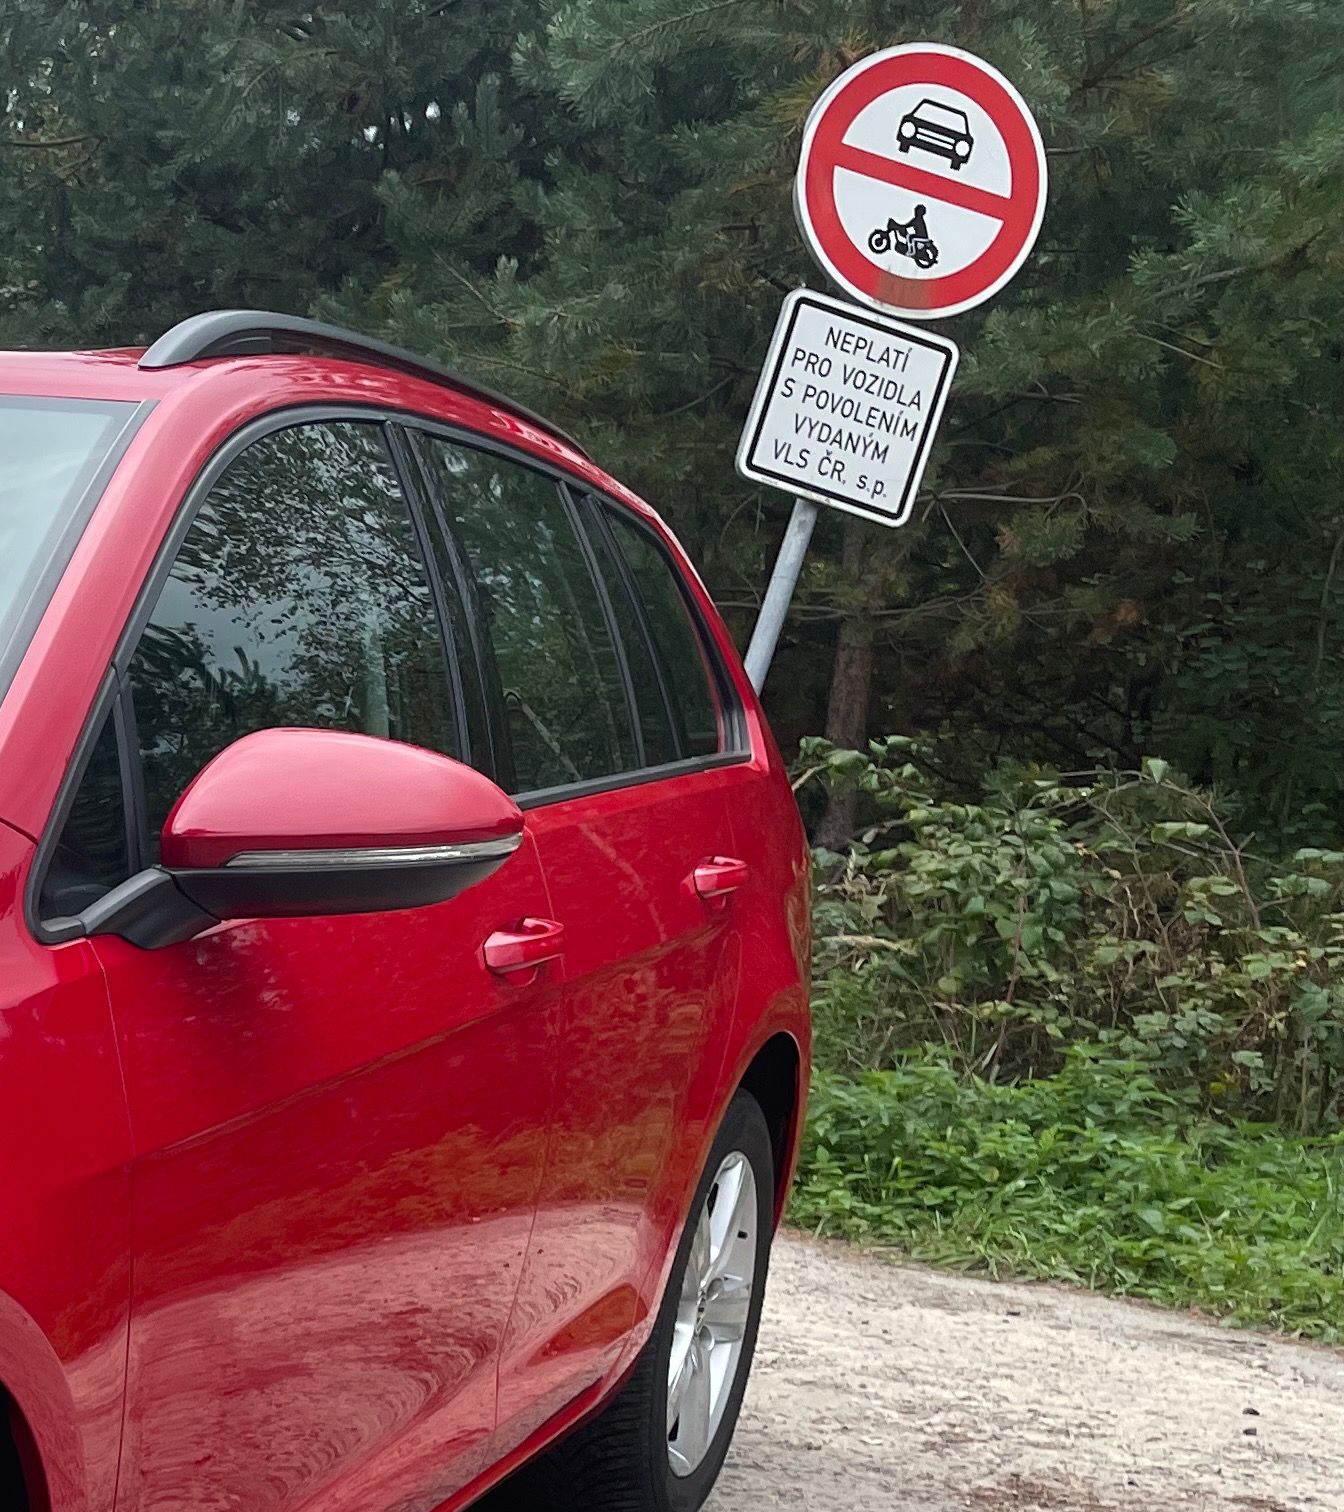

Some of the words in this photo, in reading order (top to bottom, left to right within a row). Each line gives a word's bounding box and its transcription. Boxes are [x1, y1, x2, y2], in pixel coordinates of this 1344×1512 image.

[791, 347, 832, 378] PRO
[843, 363, 922, 411] VOZIDLA
[824, 325, 913, 373] NEPLATÍ
[780, 377, 796, 399] S
[801, 384, 920, 442] POVOLENÍM
[794, 413, 890, 465] VYDANÝM
[773, 438, 811, 470] VLS
[855, 474, 888, 500] s.p.
